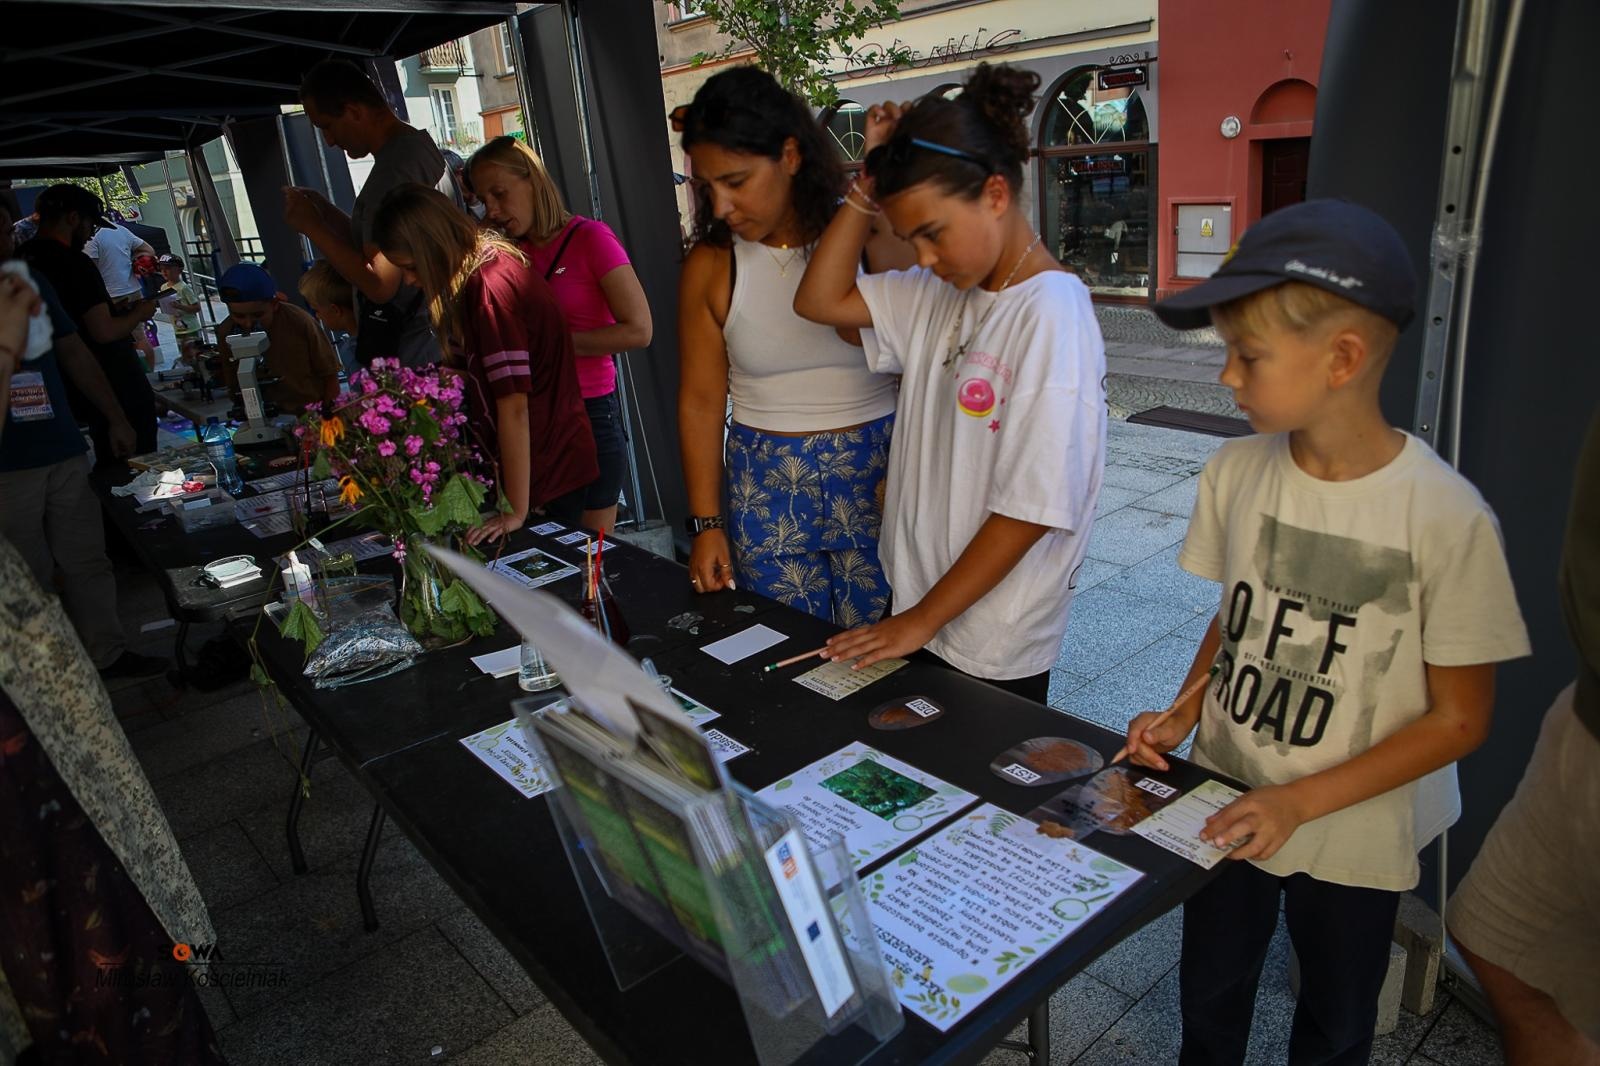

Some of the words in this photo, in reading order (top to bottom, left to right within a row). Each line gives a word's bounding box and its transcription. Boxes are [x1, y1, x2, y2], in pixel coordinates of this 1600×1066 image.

[1227, 580, 1357, 675] OFF
[1216, 649, 1335, 748] ROAD
[1005, 764, 1038, 783] KSY
[1138, 779, 1173, 797] PAL
[963, 885, 1000, 907] zbrodni
[1008, 872, 1052, 897] Obejrzyj
[960, 897, 987, 914] kilka
[912, 909, 962, 940] najrzadsze
[990, 914, 1019, 931] sobie
[1003, 907, 1044, 931] miejscu
[927, 932, 969, 959] Ogrodzie
